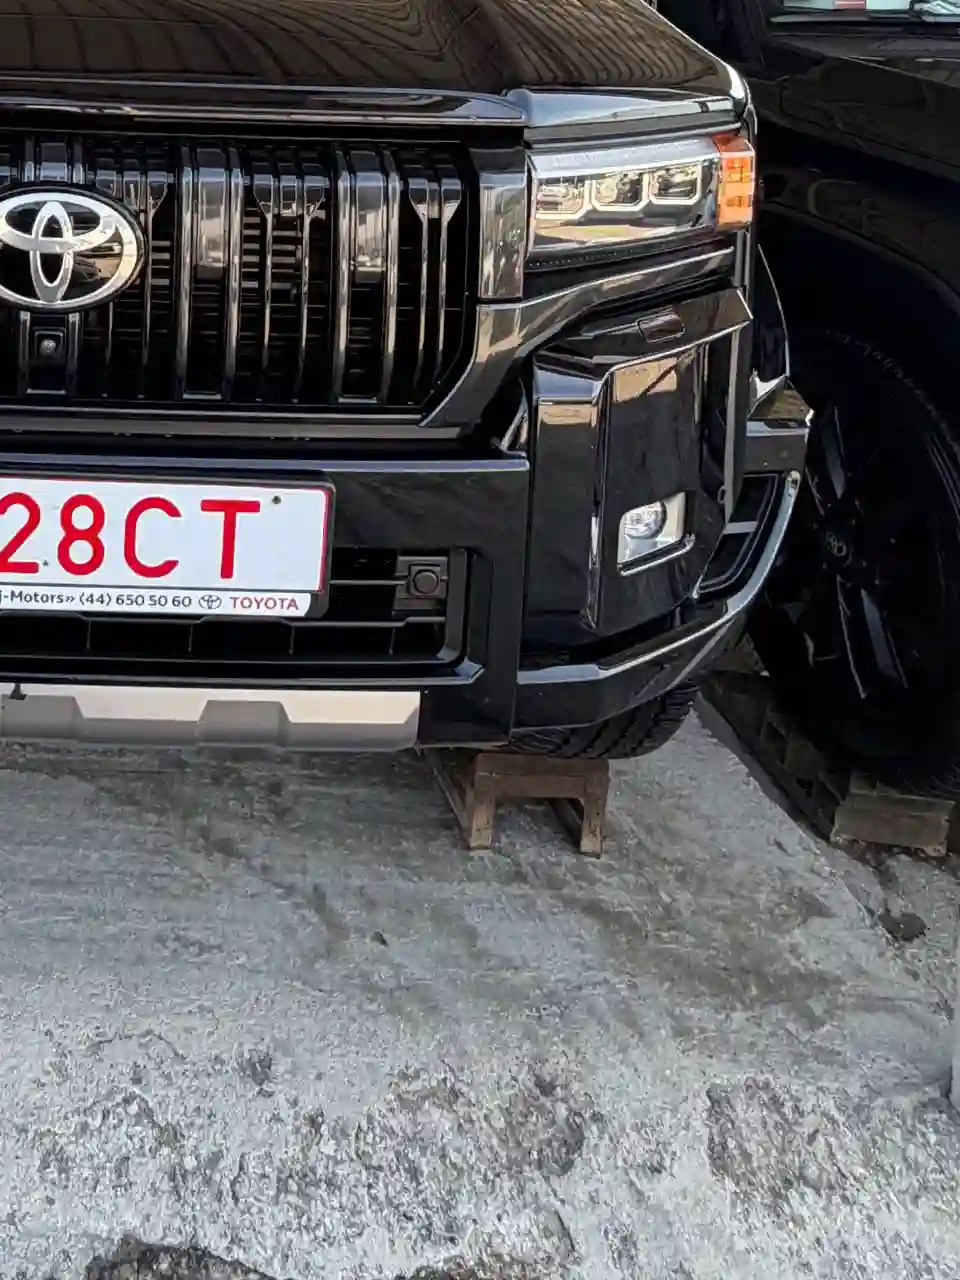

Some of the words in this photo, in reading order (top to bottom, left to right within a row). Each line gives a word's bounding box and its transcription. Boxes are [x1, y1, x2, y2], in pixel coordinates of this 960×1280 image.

[79, 591, 112, 606] (44)
[116, 593, 145, 607] 650
[148, 594, 170, 607] 50
[172, 595, 192, 608] 60
[230, 596, 299, 611] TOYOTA
